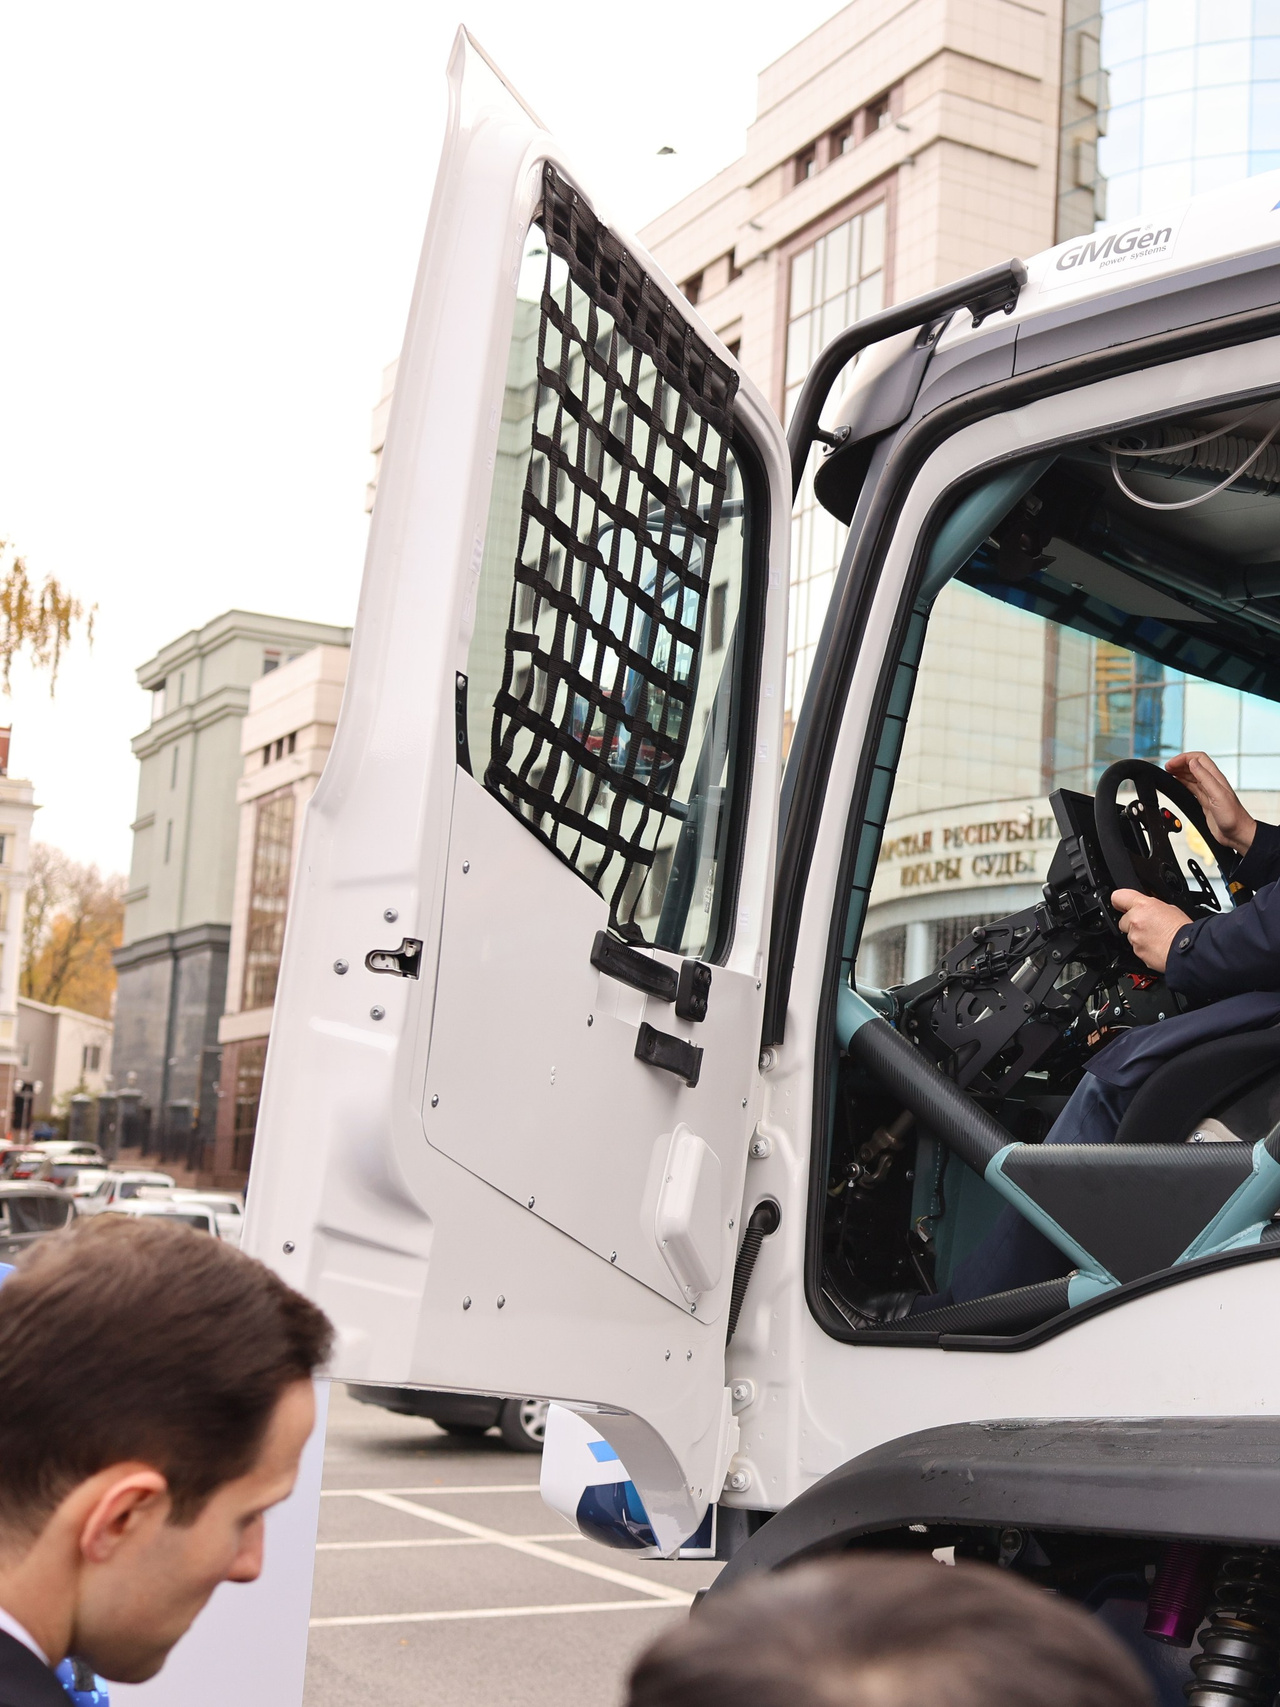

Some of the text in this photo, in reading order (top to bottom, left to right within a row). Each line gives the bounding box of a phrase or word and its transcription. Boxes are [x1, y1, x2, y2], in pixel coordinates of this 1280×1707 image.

[1056, 227, 1172, 271] GMGen
[1099, 245, 1167, 269] power systems
[943, 816, 1060, 849] РЕСПУБЛИ
[972, 851, 1037, 878] СУДЫ
